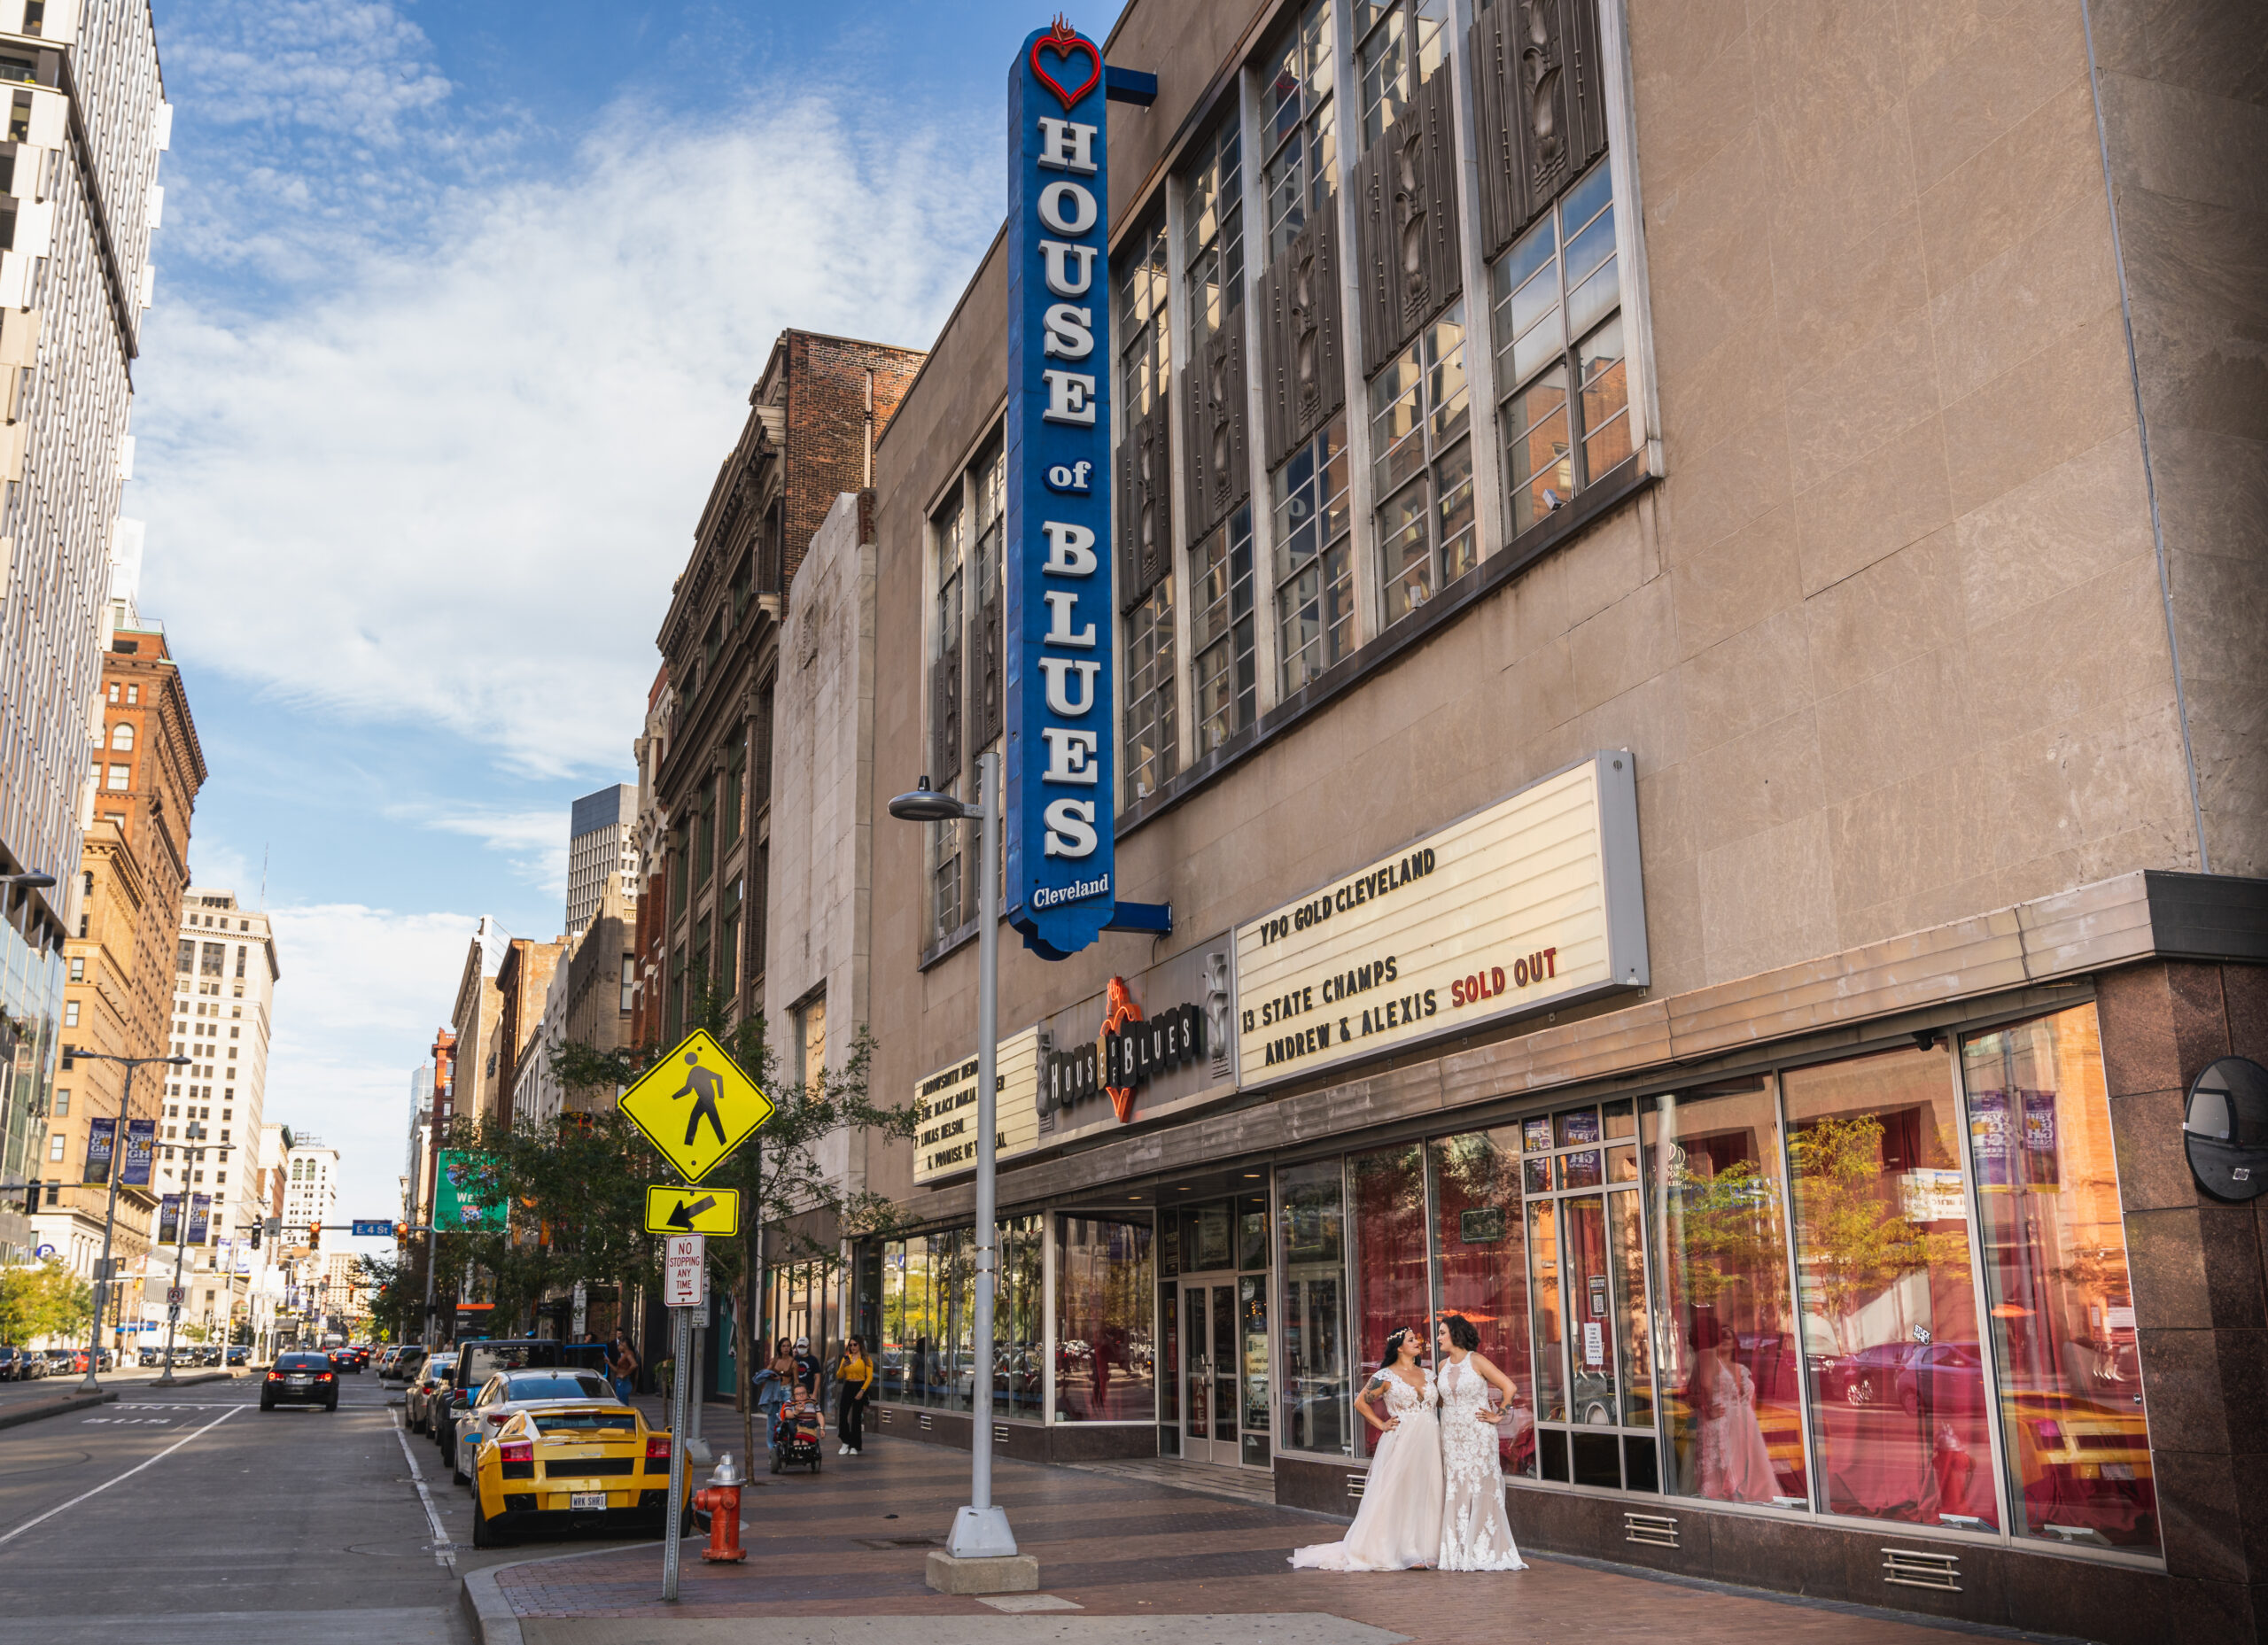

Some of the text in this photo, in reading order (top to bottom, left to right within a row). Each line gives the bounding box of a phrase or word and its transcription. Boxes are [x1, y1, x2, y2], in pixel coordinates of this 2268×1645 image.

[1037, 115, 1099, 427] HOUSE
[1048, 460, 1091, 489] of
[1037, 521, 1101, 858] BLUES
[1032, 873, 1109, 909] Cleveland
[1260, 847, 1436, 946] YPO GOLD CLEVELAND
[1242, 956, 1398, 1034] 13 STATE CHAMPS
[1264, 947, 1557, 1067] ANDREW & ALEXIS SOLD OUT
[1051, 1051, 1105, 1098] HOUSE
[1123, 1018, 1190, 1075] BLUES
[935, 1095, 954, 1117] BLACK
[920, 1127, 939, 1147] LUKAS
[935, 1145, 962, 1168] PROMISE
[965, 1142, 973, 1159] OF
[377, 1225, 388, 1234] St
[678, 1242, 692, 1254] NO
[669, 1256, 700, 1267] STOPPING
[677, 1269, 691, 1277] ANY
[676, 1280, 692, 1289] TIME
[573, 1495, 604, 1506] WRK SHRT
